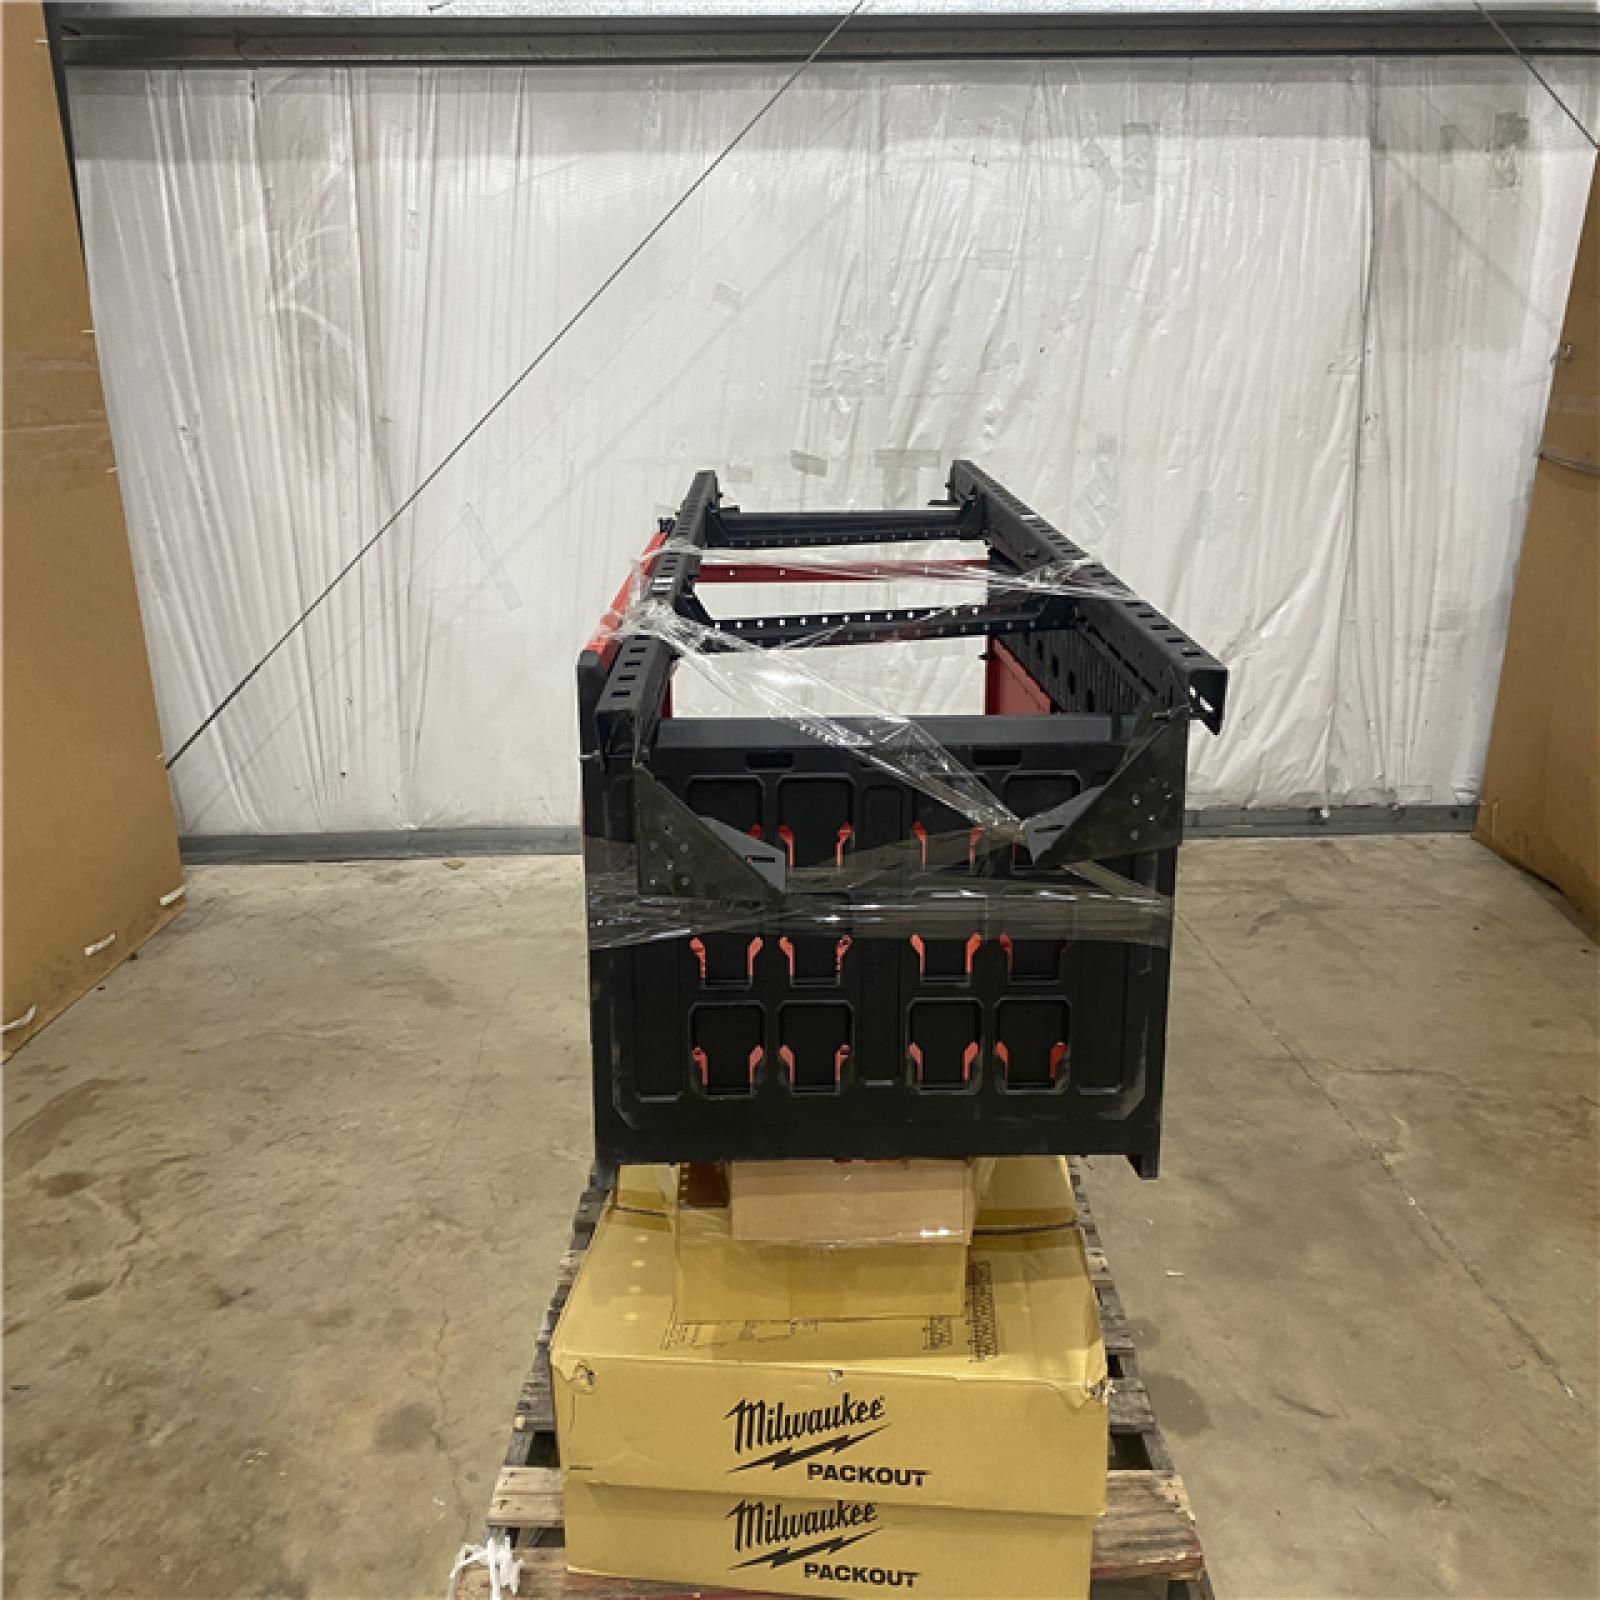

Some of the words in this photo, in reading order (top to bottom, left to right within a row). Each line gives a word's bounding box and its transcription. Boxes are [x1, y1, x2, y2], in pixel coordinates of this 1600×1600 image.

[724, 1392, 885, 1455] Milwaukee
[807, 1463, 931, 1487] PACKOUT
[726, 1499, 879, 1553] Milwaukee
[804, 1562, 920, 1588] PACKOUT
